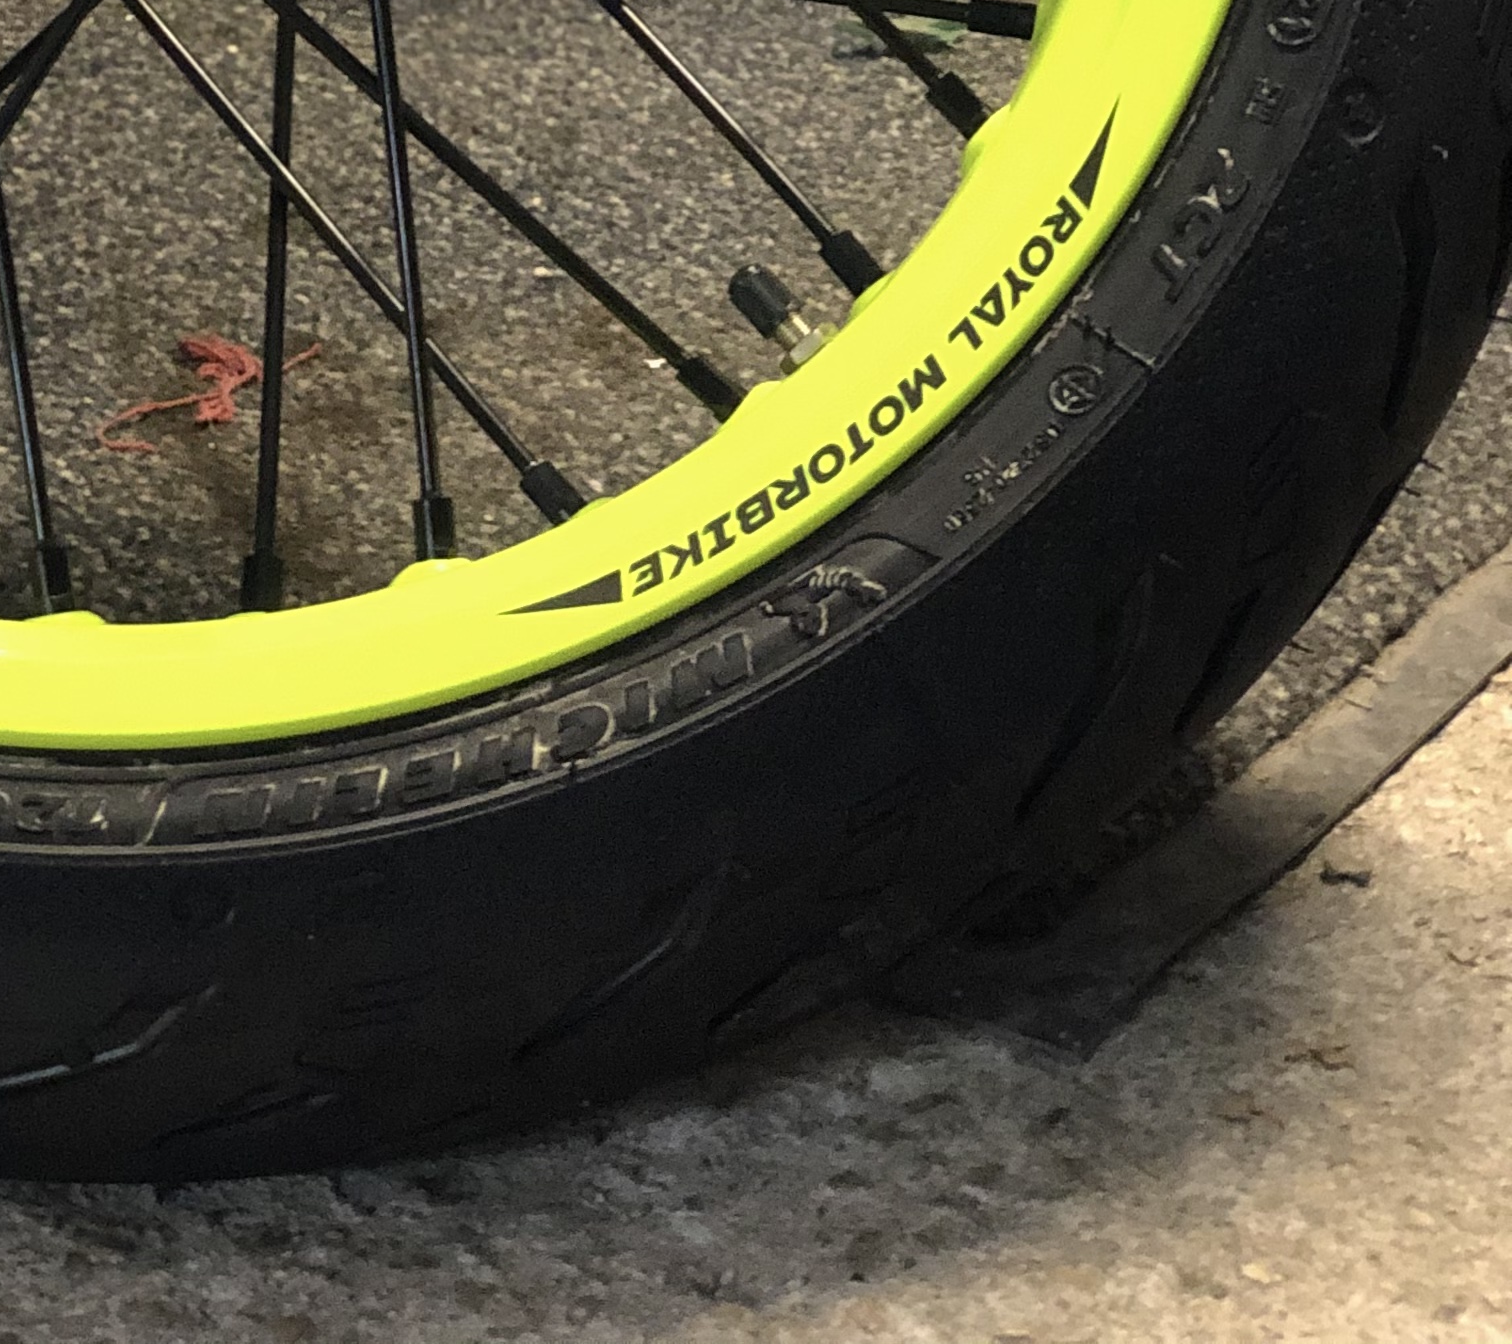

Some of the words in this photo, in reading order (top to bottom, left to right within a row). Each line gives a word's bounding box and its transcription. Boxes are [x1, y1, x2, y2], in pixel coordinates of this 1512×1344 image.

[949, 195, 1083, 351] ROYAL
[629, 353, 947, 598] MOTORBIKE
[191, 627, 770, 837] MICHELIN
